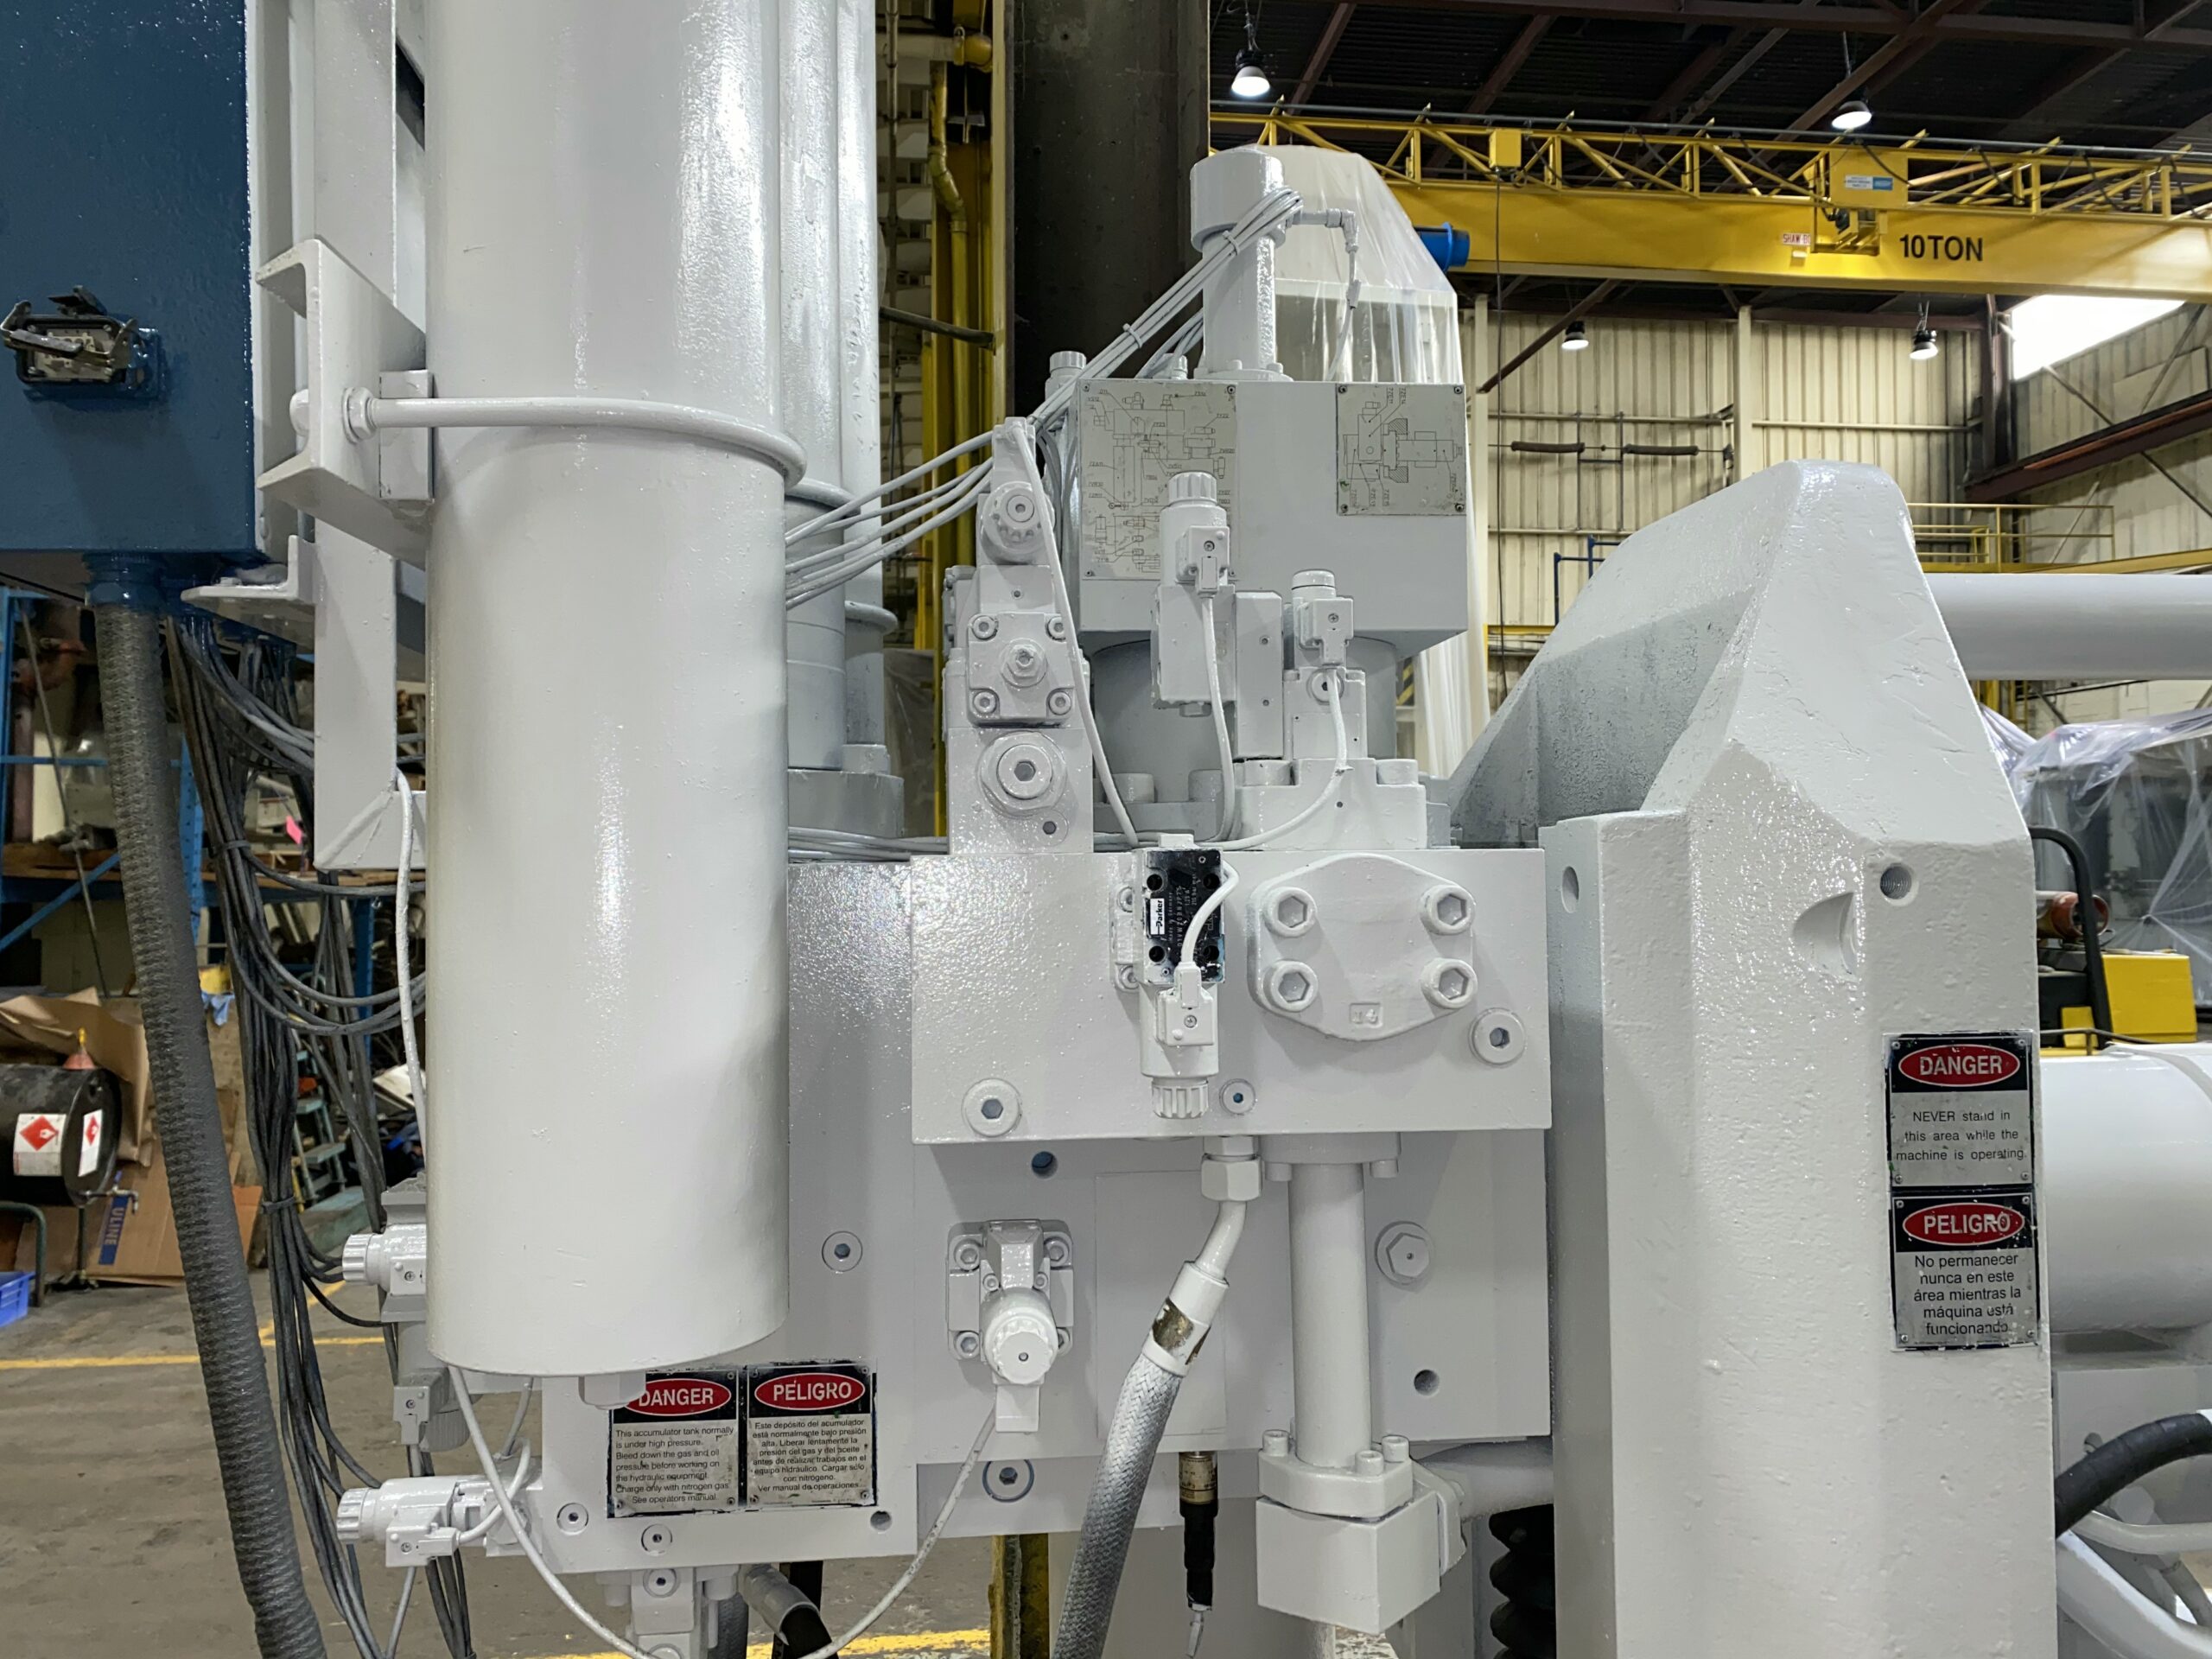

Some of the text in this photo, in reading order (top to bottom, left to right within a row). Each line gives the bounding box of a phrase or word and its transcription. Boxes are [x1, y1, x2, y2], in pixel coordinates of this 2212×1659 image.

[1920, 1055, 2002, 1075] DANGER
[1913, 1110, 2010, 1122] NEVER stand in
[1905, 1129, 2018, 1141] this area while the
[1896, 1147, 2027, 1160] machine is operating.
[104, 1207, 124, 1245] ULINE
[1924, 1211, 2011, 1235] PELIGRO
[1915, 1254, 2018, 1268] No permanecer
[1920, 1271, 2014, 1285] nunca en este
[1914, 1286, 2021, 1301] área mientras la
[1923, 1306, 1982, 1319] máquina
[639, 1388, 714, 1407] DANGER
[773, 1382, 852, 1402] PELIGRO
[634, 1428, 681, 1437] accumulator
[702, 1427, 734, 1435] normally
[616, 1462, 649, 1471] pressure
[630, 1473, 664, 1483] hydraulic
[616, 1484, 644, 1493] Charge
[646, 1484, 662, 1493] only
[681, 1483, 712, 1491] nitrogen
[649, 1495, 685, 1504] operators
